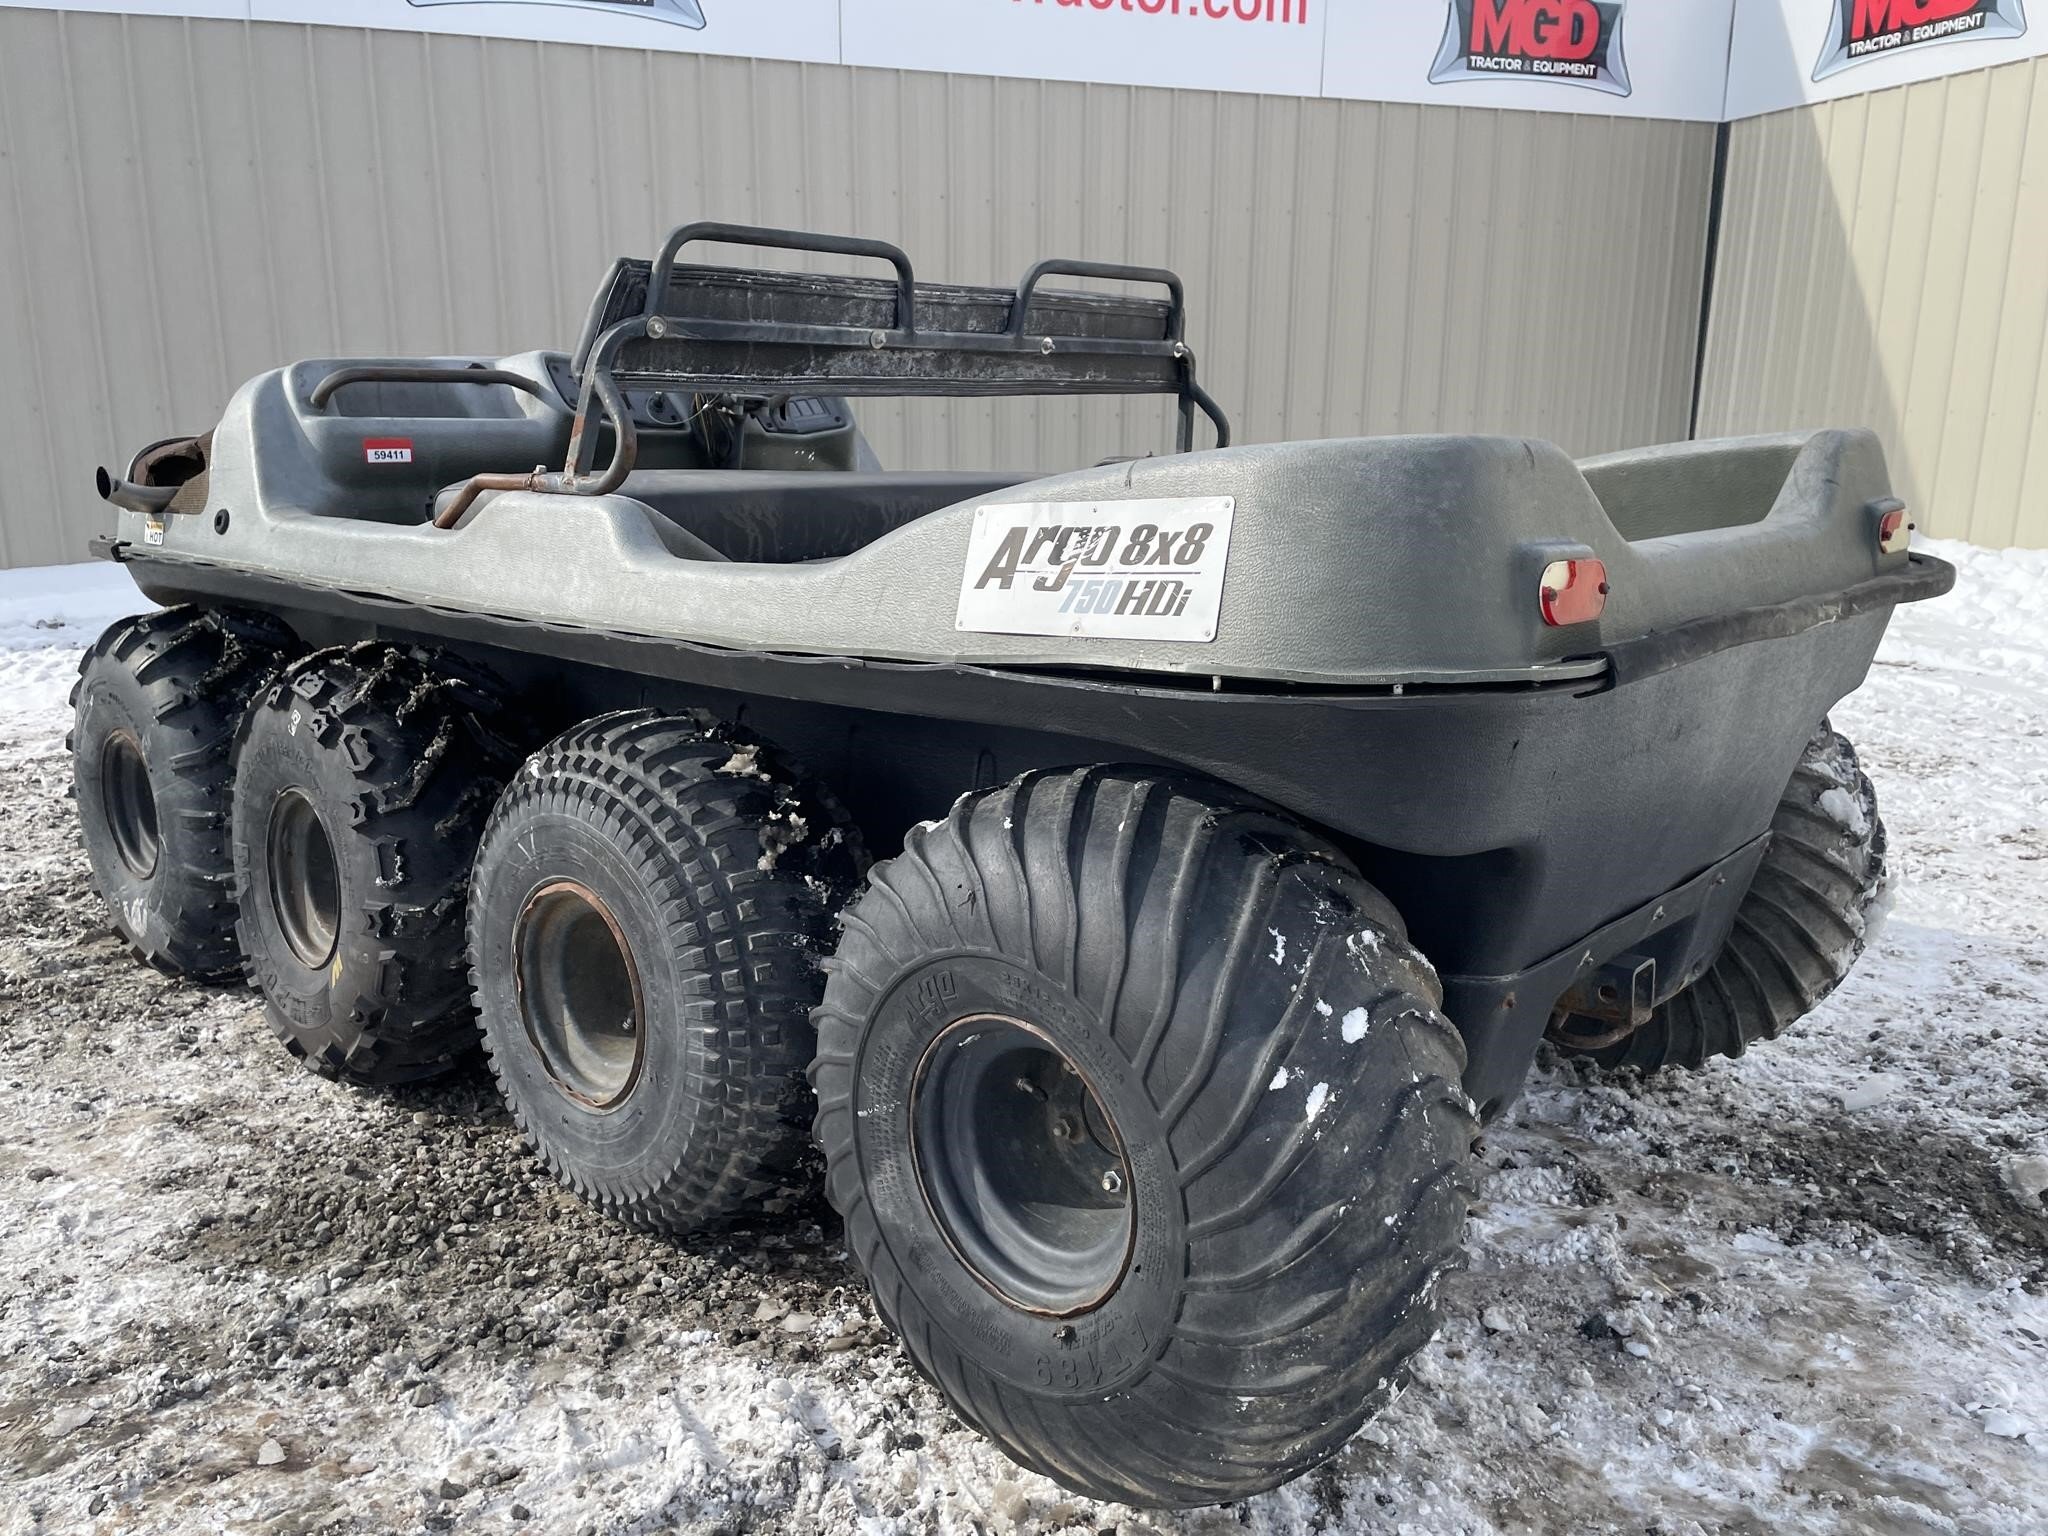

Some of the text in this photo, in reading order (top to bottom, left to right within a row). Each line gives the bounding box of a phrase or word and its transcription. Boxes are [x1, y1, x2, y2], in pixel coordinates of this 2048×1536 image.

[1470, 0, 1600, 60] MGD
[1850, 32, 1902, 56] TRACTOR
[1902, 30, 1911, 43] &
[1912, 12, 1984, 41] EQUIPMENT
[1469, 55, 1597, 77] TRACTOR & EQUIPMENT
[374, 450, 404, 460] 59411
[1119, 522, 1215, 566] 8x8
